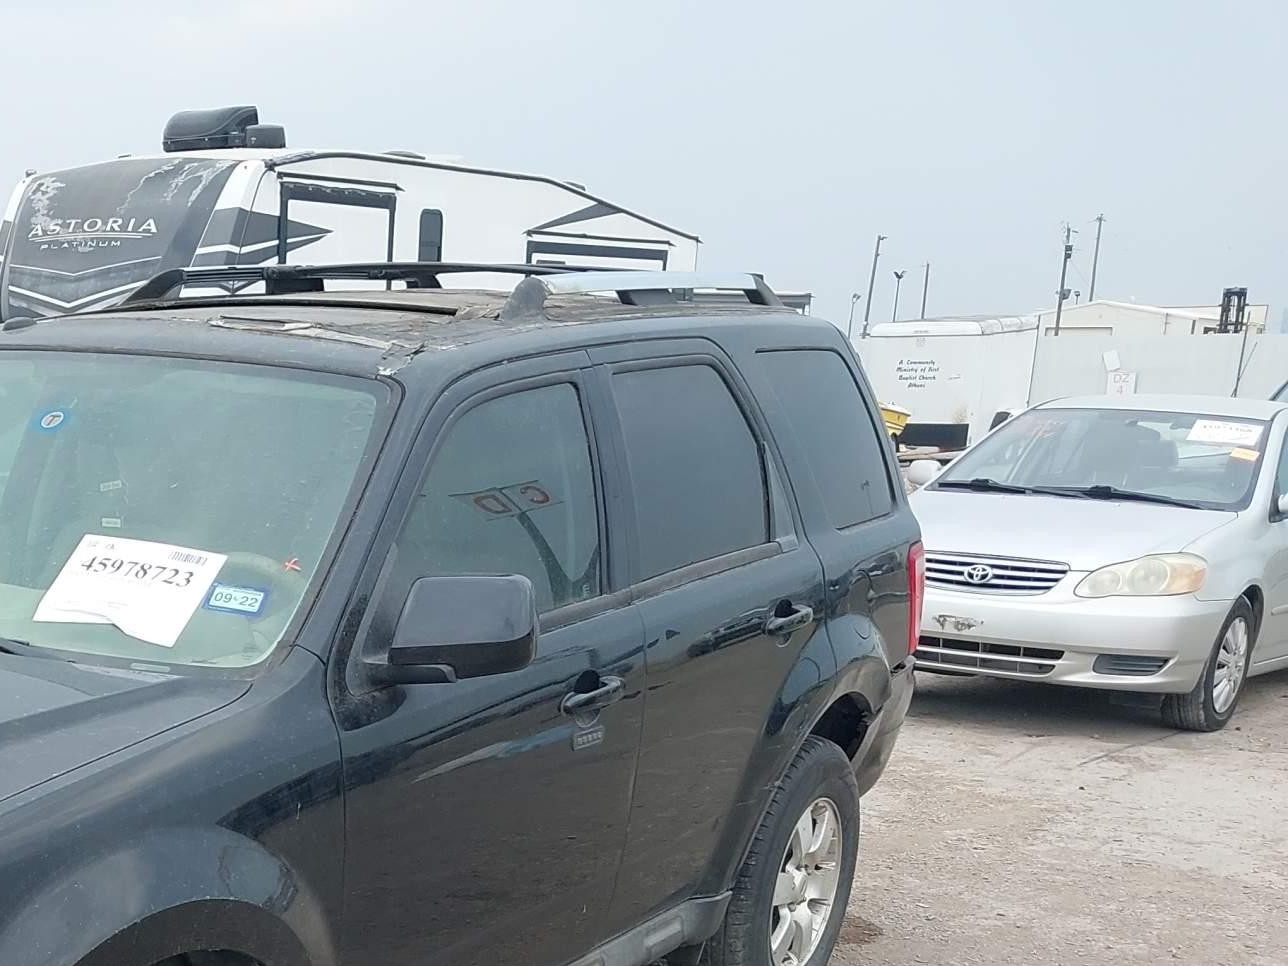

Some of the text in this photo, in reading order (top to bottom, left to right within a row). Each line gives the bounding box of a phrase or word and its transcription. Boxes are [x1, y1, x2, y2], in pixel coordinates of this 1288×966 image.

[28, 218, 158, 238] ASTORIA
[39, 240, 121, 250] PLATINUM
[81, 555, 194, 588] 45978723
[240, 595, 259, 608] 22
